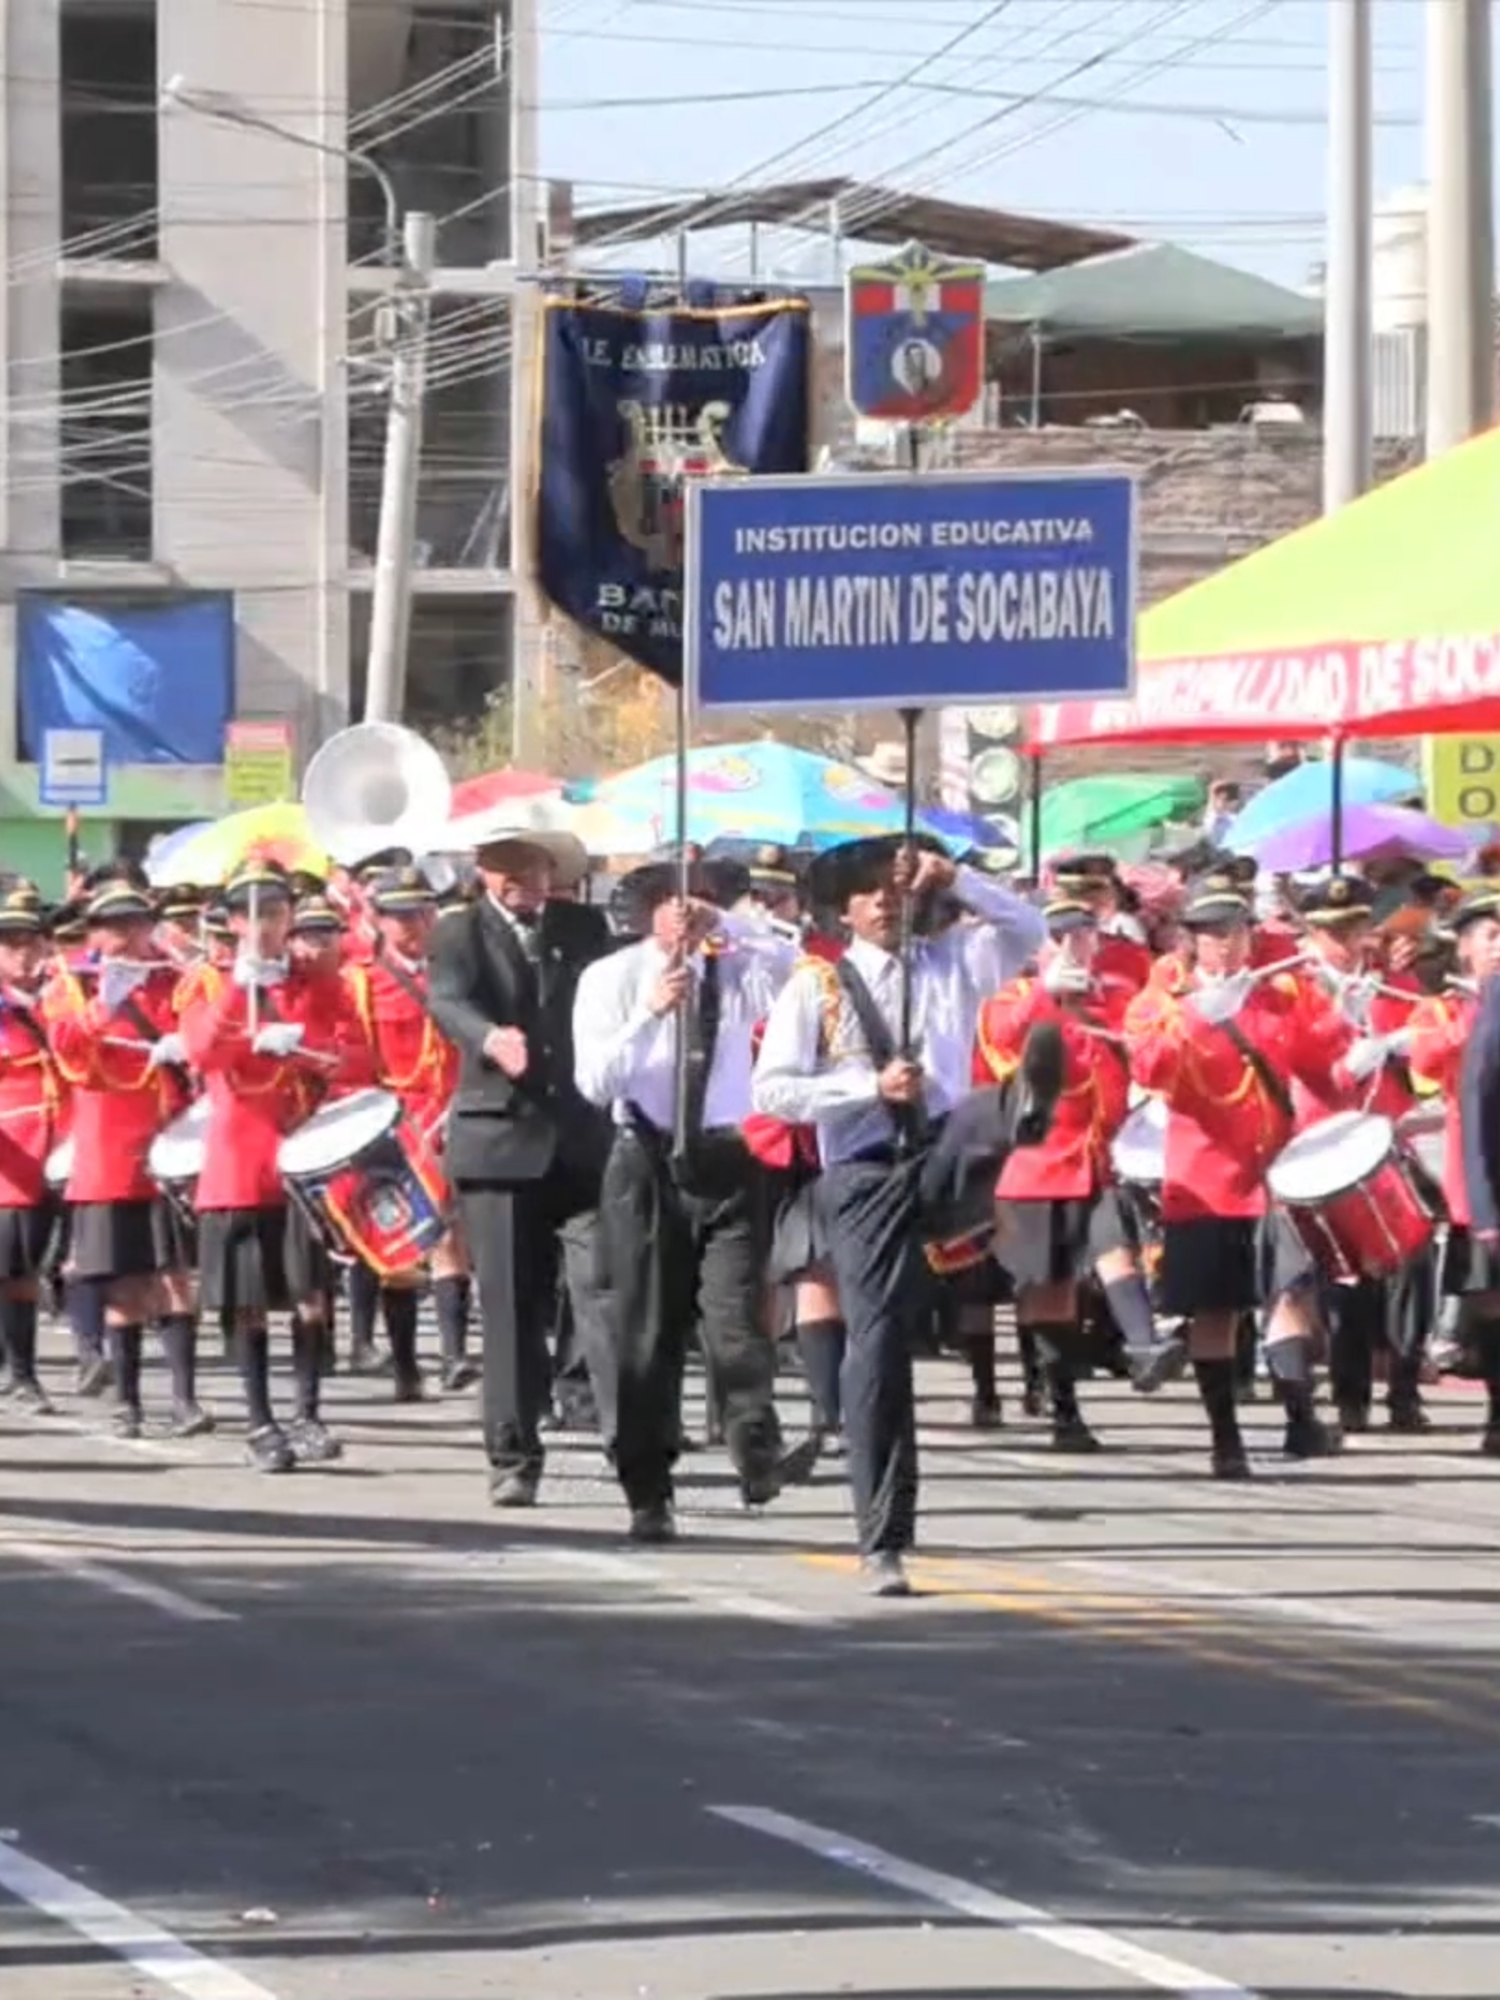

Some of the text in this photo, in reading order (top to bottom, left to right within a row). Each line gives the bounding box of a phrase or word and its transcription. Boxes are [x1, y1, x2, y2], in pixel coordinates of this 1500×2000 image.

[735, 518, 1093, 553] INSTITUCION EDUCATIVA
[598, 583, 683, 617] BAN
[714, 567, 1115, 650] SAN MARTIN DE SOCABAYA
[1360, 643, 1403, 714] DE
